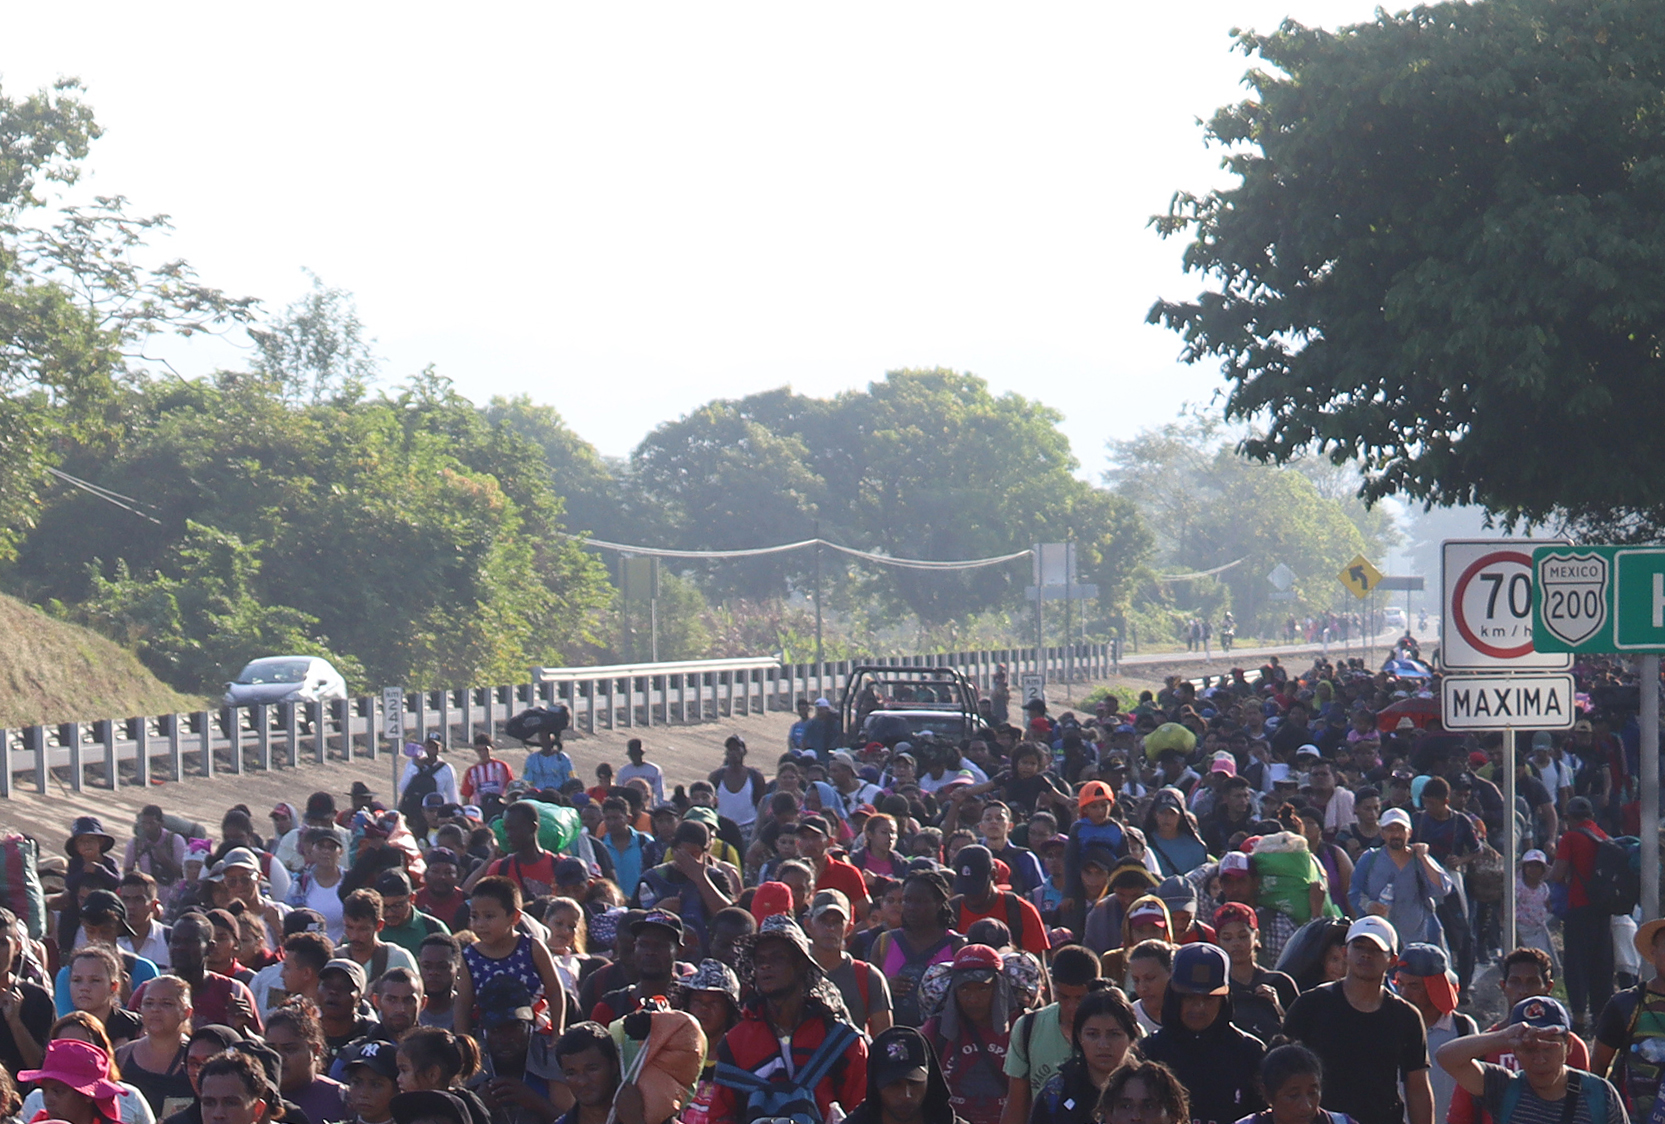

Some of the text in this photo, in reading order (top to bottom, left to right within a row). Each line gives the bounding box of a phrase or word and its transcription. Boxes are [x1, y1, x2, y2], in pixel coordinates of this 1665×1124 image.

[1550, 567, 1598, 577] MEXICO
[1480, 573, 1532, 619] 70
[1550, 591, 1598, 619] 200
[1452, 687, 1562, 717] MAXIMA
[360, 1043, 380, 1057] NY
